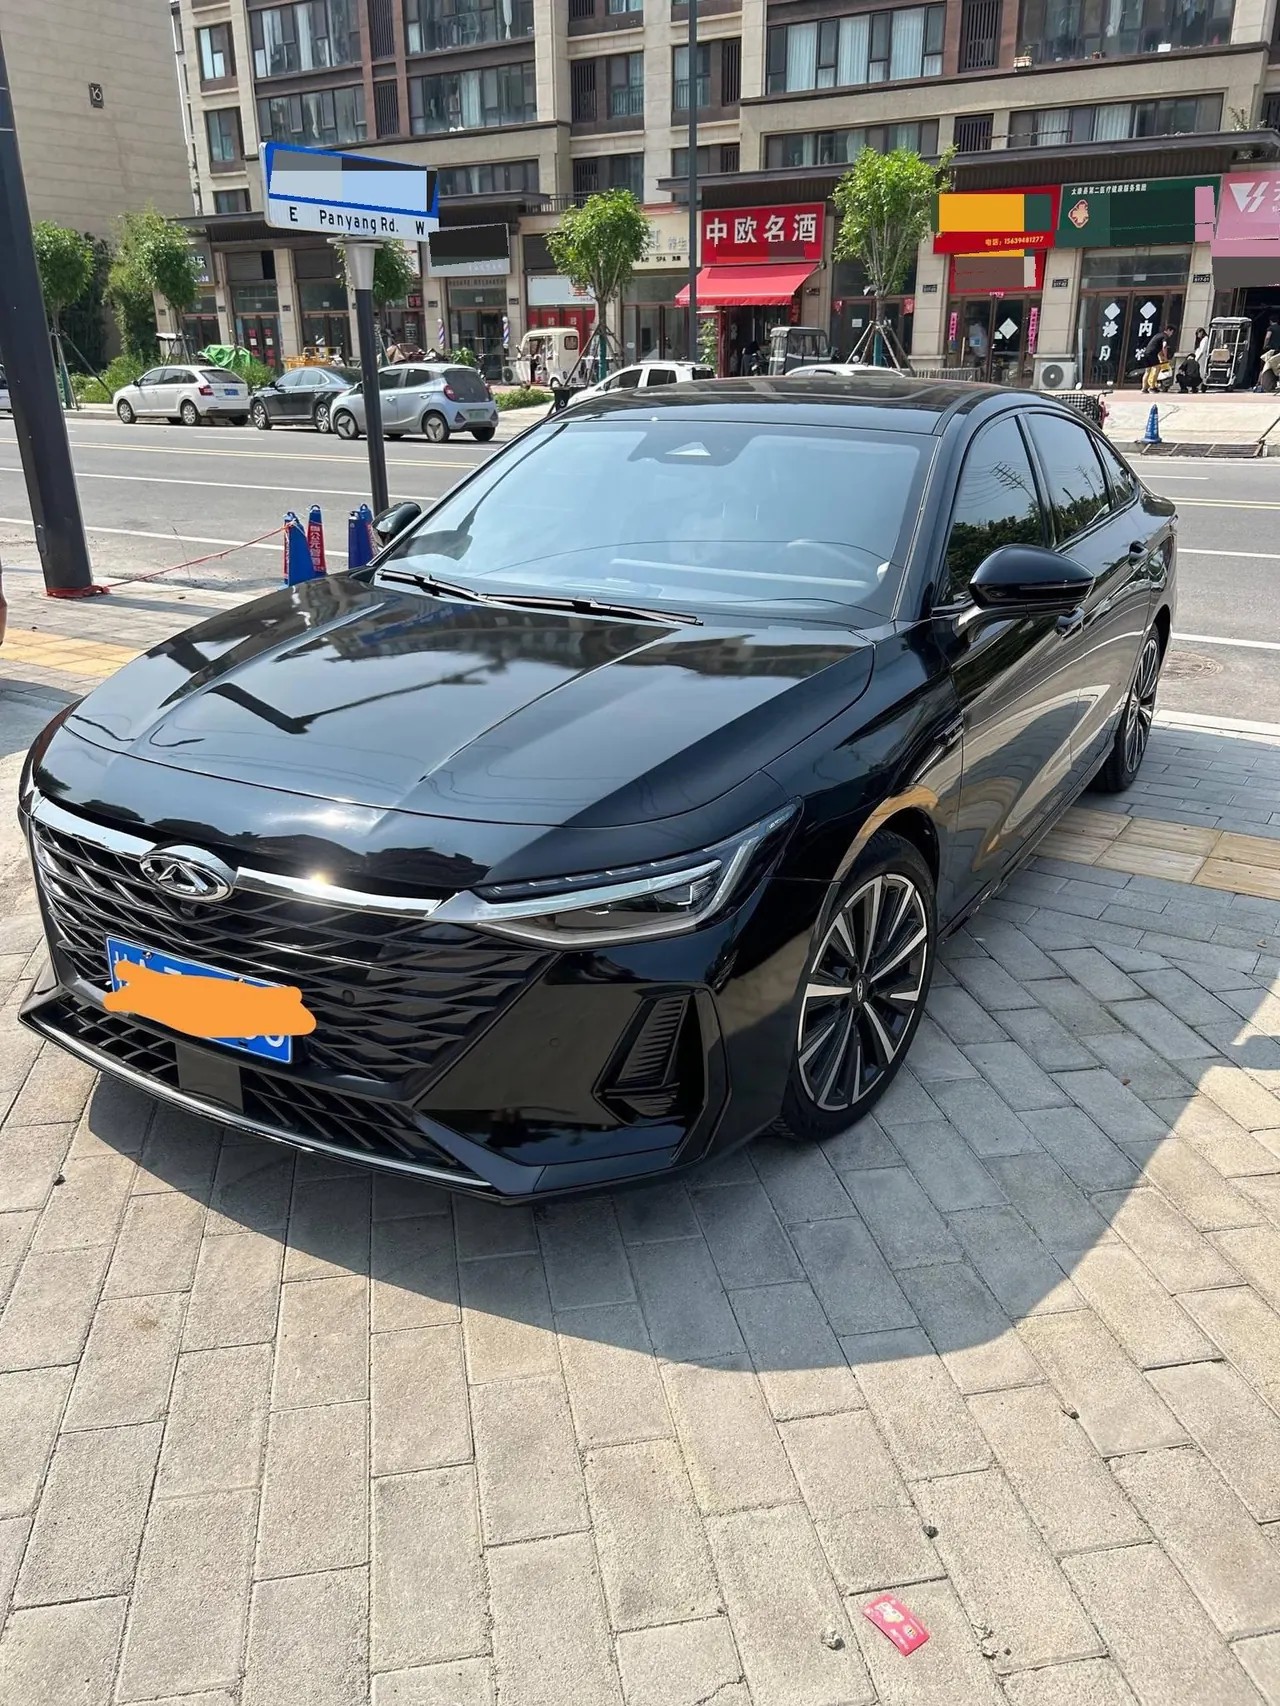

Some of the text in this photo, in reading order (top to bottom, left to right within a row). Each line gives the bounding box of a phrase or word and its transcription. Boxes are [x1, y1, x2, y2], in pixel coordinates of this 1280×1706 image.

[289, 206, 425, 235] E Panyang Rd. W
[705, 213, 817, 248] 中欧名酒
